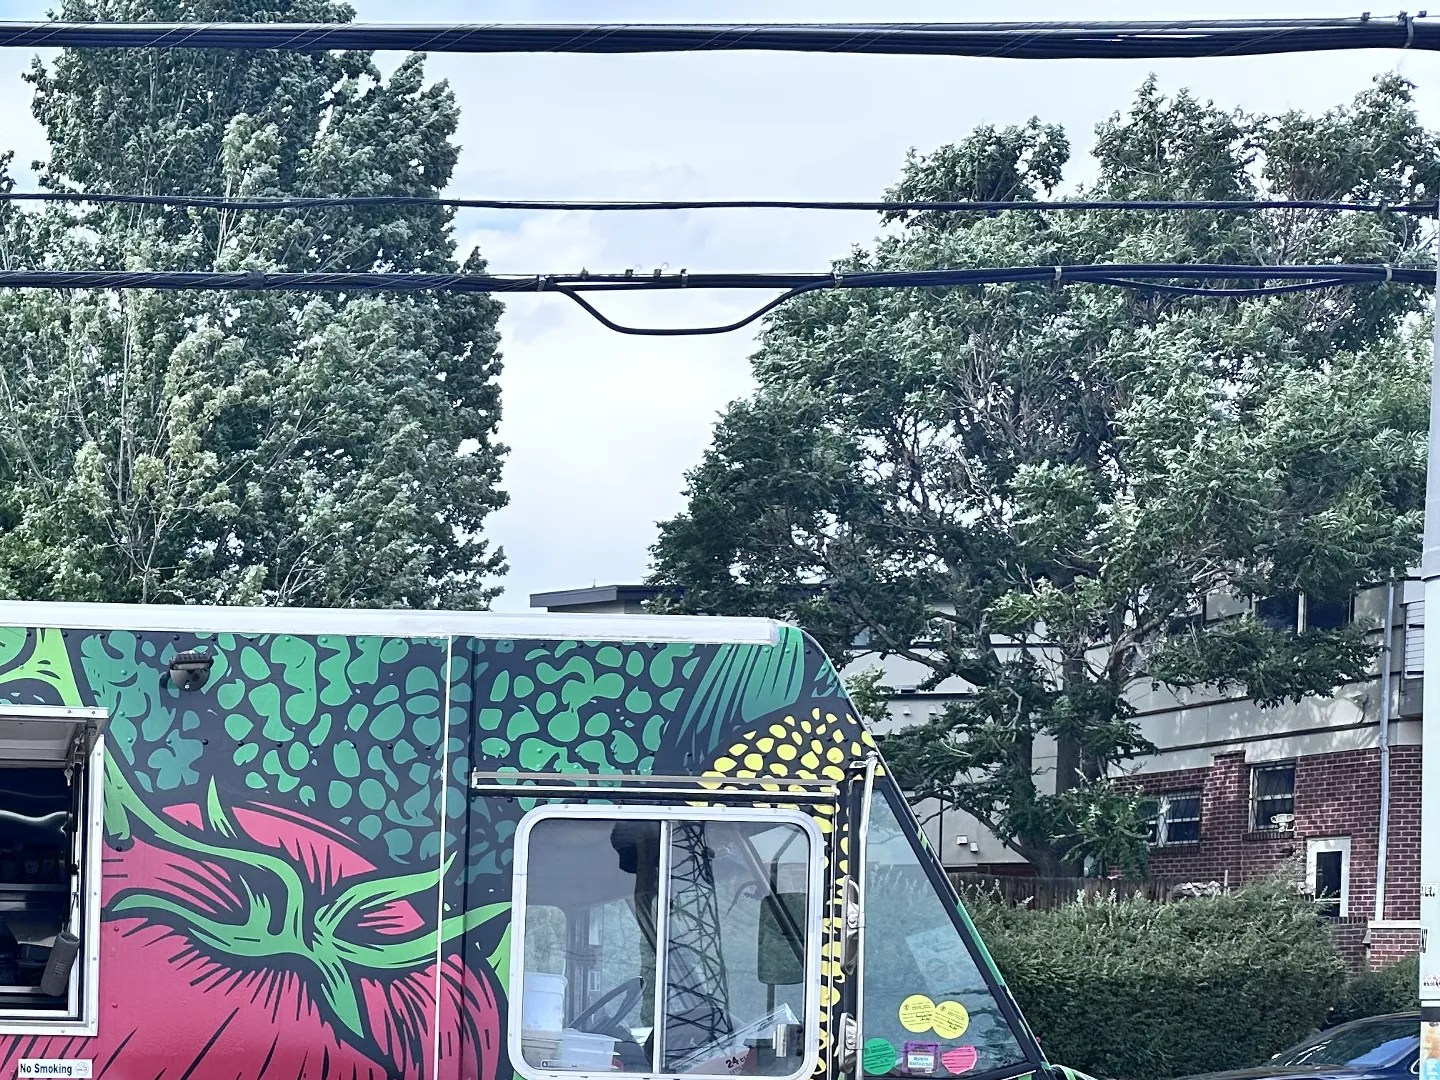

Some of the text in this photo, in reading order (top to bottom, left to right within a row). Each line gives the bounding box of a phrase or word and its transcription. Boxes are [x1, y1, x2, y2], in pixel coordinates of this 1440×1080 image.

[725, 1056, 739, 1069] 24
[20, 1063, 72, 1076] No Smoking
